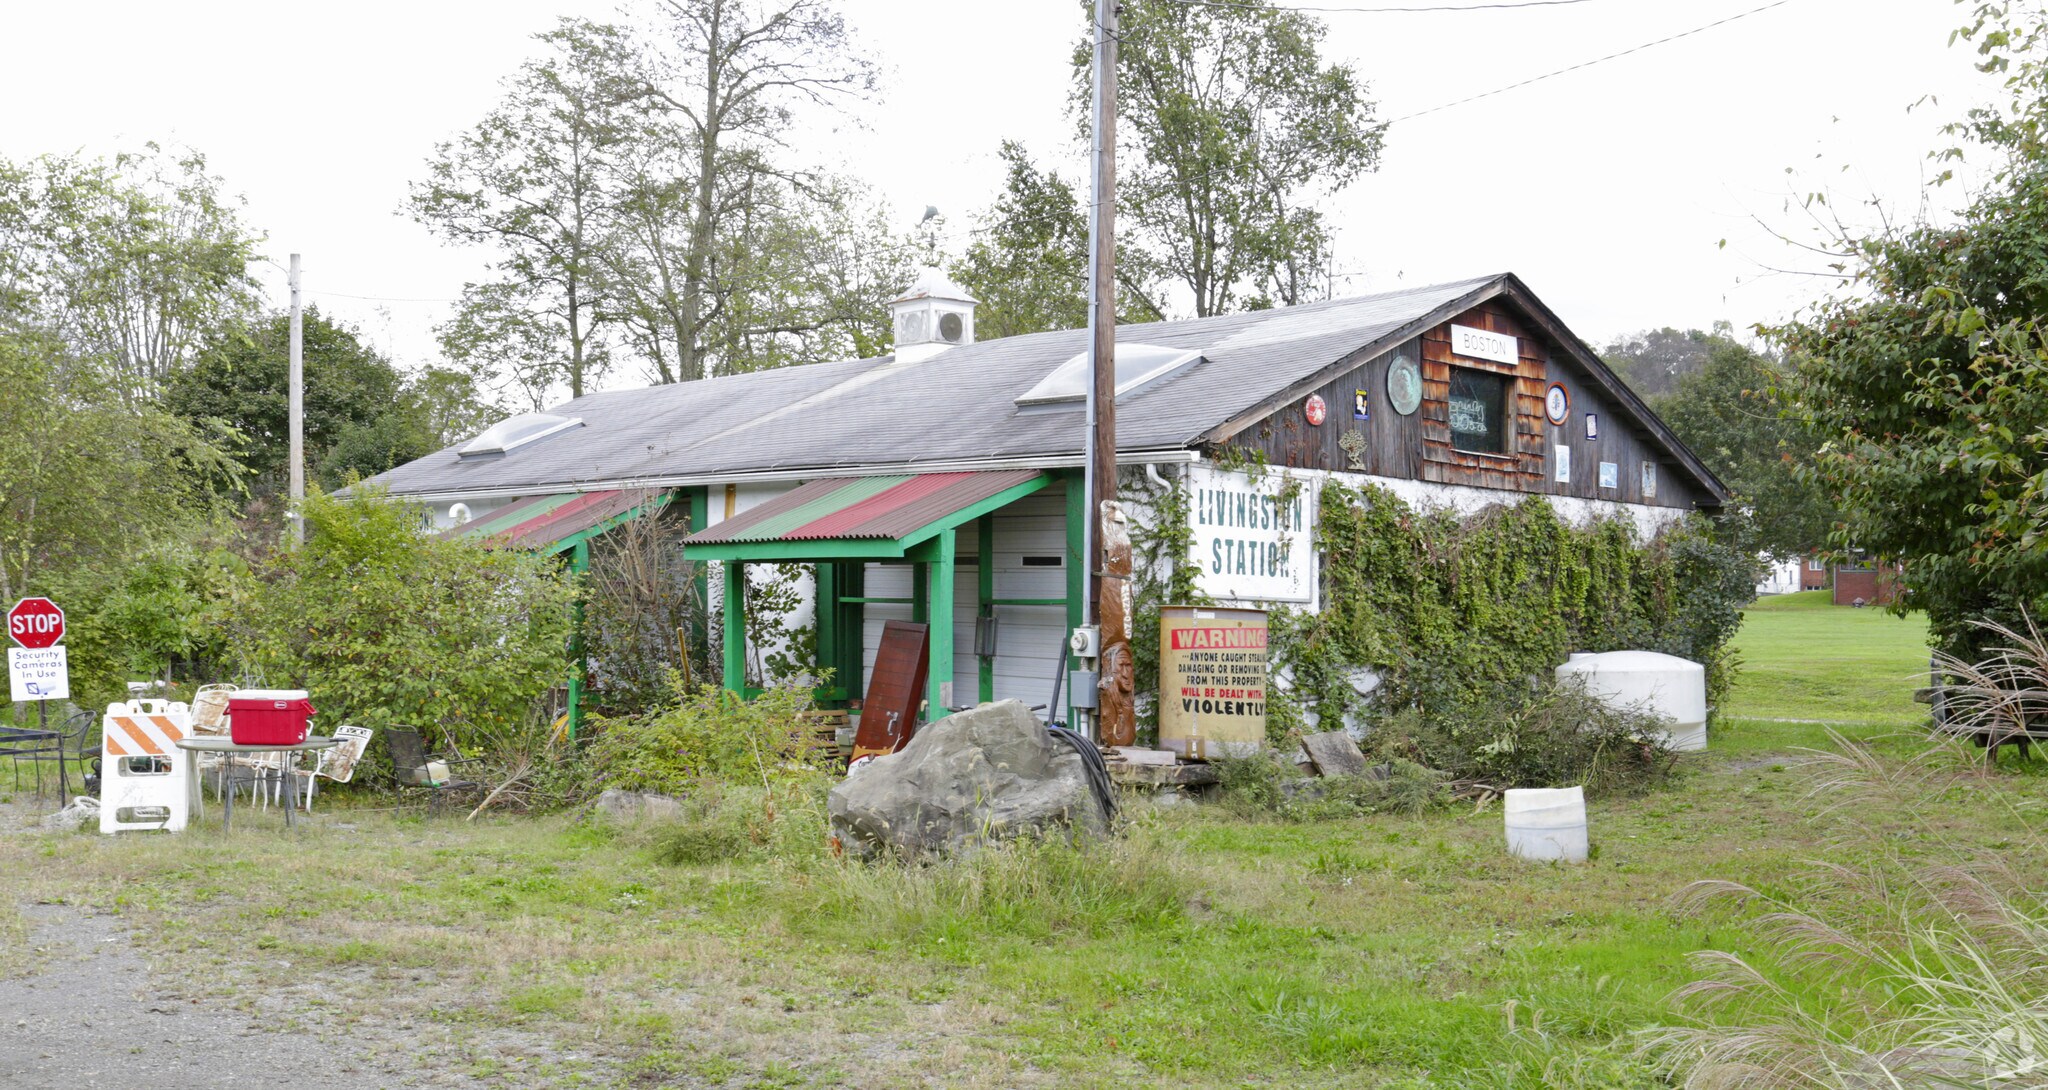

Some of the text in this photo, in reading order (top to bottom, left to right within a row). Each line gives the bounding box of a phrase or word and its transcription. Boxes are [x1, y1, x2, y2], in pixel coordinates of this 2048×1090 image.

[1464, 334, 1506, 355] BOSTON
[1199, 489, 1302, 532] LIVINGSTON
[1213, 537, 1289, 577] STATION
[13, 614, 60, 634] STOP
[1177, 629, 1264, 648] WARNING
[16, 651, 59, 660] Security
[1221, 653, 1246, 662] CAUGHT
[15, 661, 62, 669] Cameras
[1179, 664, 1214, 673] DAMAGING
[1218, 664, 1227, 673] OR
[1231, 665, 1259, 674] REMOVING
[37, 670, 56, 678] Use
[1187, 676, 1207, 685] FROM
[1212, 676, 1228, 685] THIS
[1181, 687, 1200, 697] WILL
[1205, 688, 1215, 697] BE
[1220, 688, 1244, 698] DEALT
